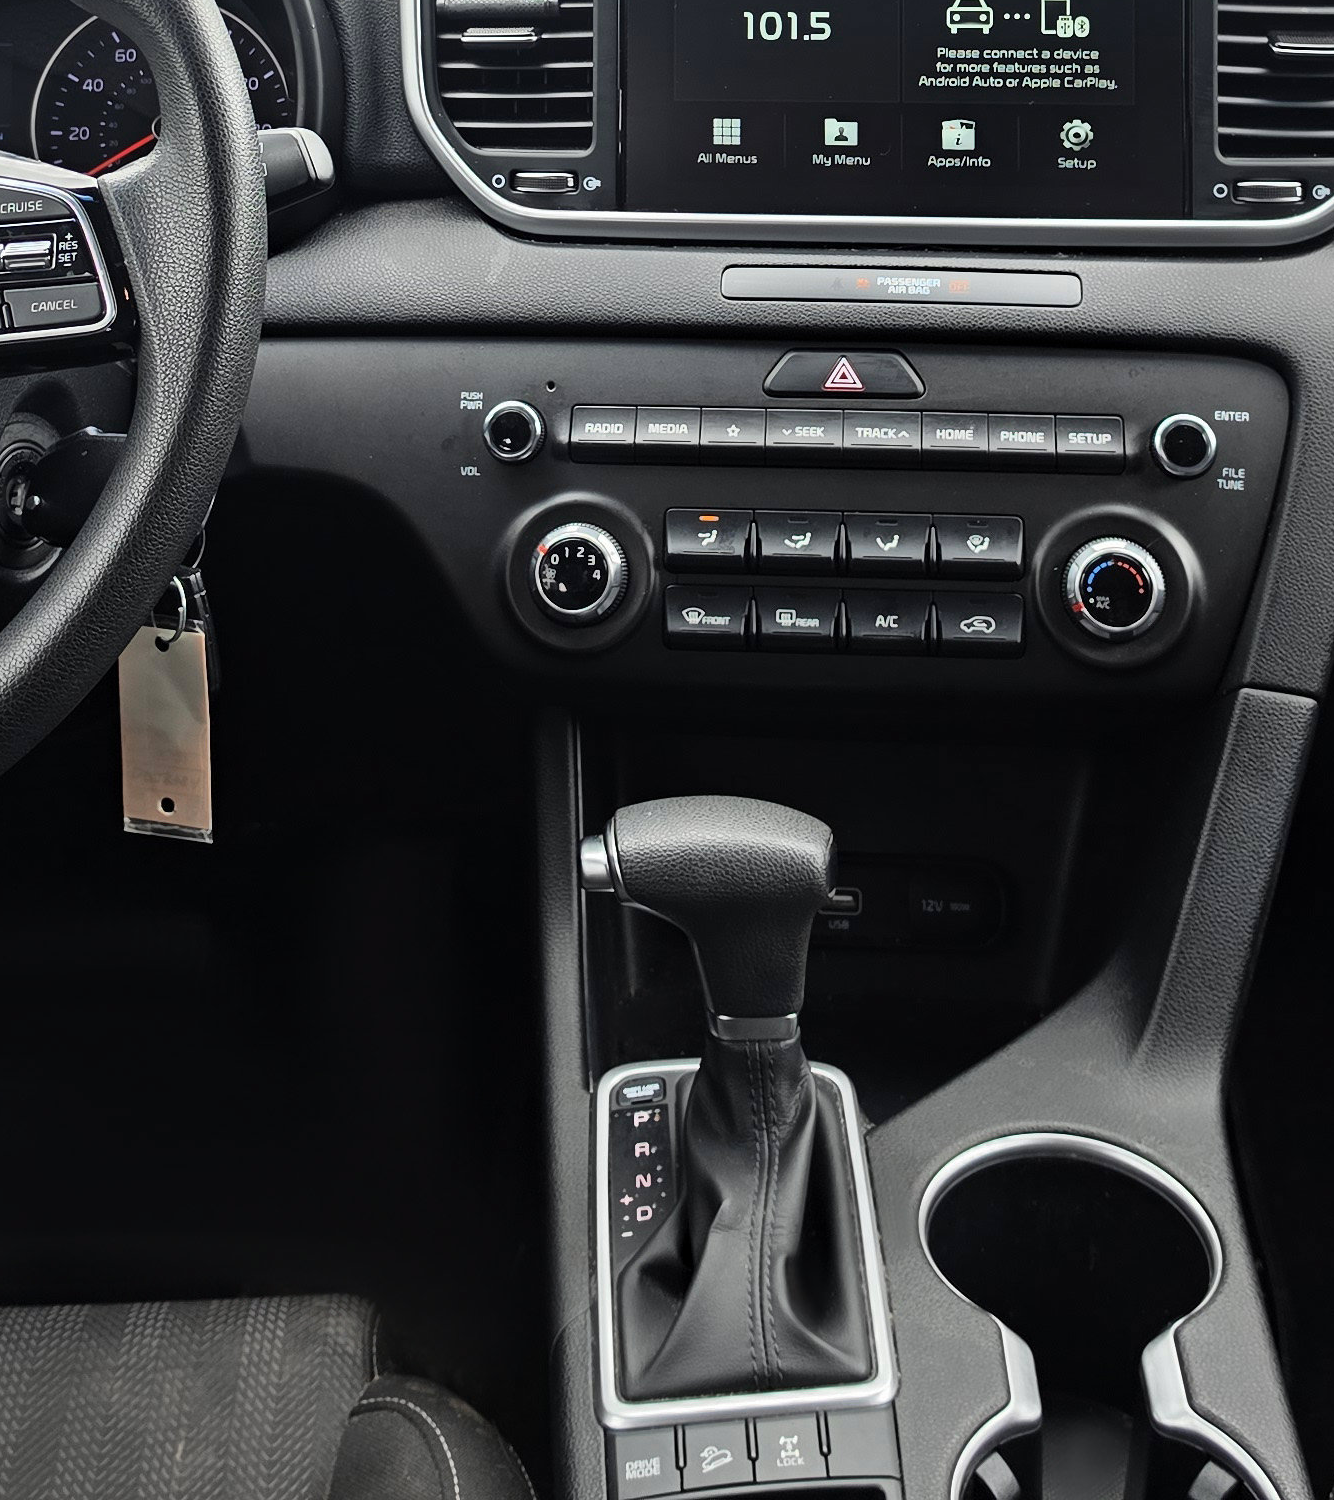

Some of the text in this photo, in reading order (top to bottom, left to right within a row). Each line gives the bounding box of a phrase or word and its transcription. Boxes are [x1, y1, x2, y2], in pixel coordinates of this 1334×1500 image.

[743, 10, 833, 42] 101.5
[114, 48, 137, 63] 60
[937, 47, 1100, 60] Please connect a device
[935, 61, 1101, 74] for more features such as
[82, 78, 104, 93] 40
[918, 75, 1119, 90] Android Auto or Apple CarPlay.
[68, 126, 90, 141] 20
[697, 152, 758, 164] All Menus
[812, 153, 871, 167] My Menu
[927, 154, 992, 169] Apps/Info
[1057, 156, 1097, 170] Setup
[0, 200, 43, 214] CRUISE
[58, 240, 79, 251] RES
[58, 252, 78, 263] SET
[877, 276, 941, 288] PASSENGER
[888, 285, 931, 295] AIR BAG
[31, 299, 78, 313] CANCEL
[460, 391, 483, 401] PUSH
[460, 400, 483, 410] PWR
[1214, 410, 1250, 422] ENTER
[584, 422, 624, 436] RADIO
[647, 422, 689, 436] MEDIA
[794, 425, 825, 438] SEEK
[855, 426, 898, 440] TRACK
[935, 428, 974, 441] HOME
[999, 430, 1045, 444] PHONE
[1068, 432, 1112, 446] SETUP
[460, 466, 481, 477] VOL
[1222, 467, 1246, 479] FILE
[1216, 478, 1245, 491] TUNE
[564, 546, 570, 558] 1
[576, 546, 585, 558] 2
[550, 553, 560, 565] 0
[587, 554, 596, 566] 3
[592, 569, 601, 581] 4
[701, 615, 731, 625] FRONT
[795, 617, 820, 628] REAR
[875, 614, 899, 628] A/C
[921, 898, 944, 913] 12V
[634, 1110, 651, 1128] P
[634, 1141, 651, 1157] R
[634, 1173, 652, 1188] N
[636, 1205, 653, 1221] D
[625, 1457, 660, 1471] DRIVE
[776, 1457, 805, 1467] LOCK
[625, 1467, 661, 1481] MODE
